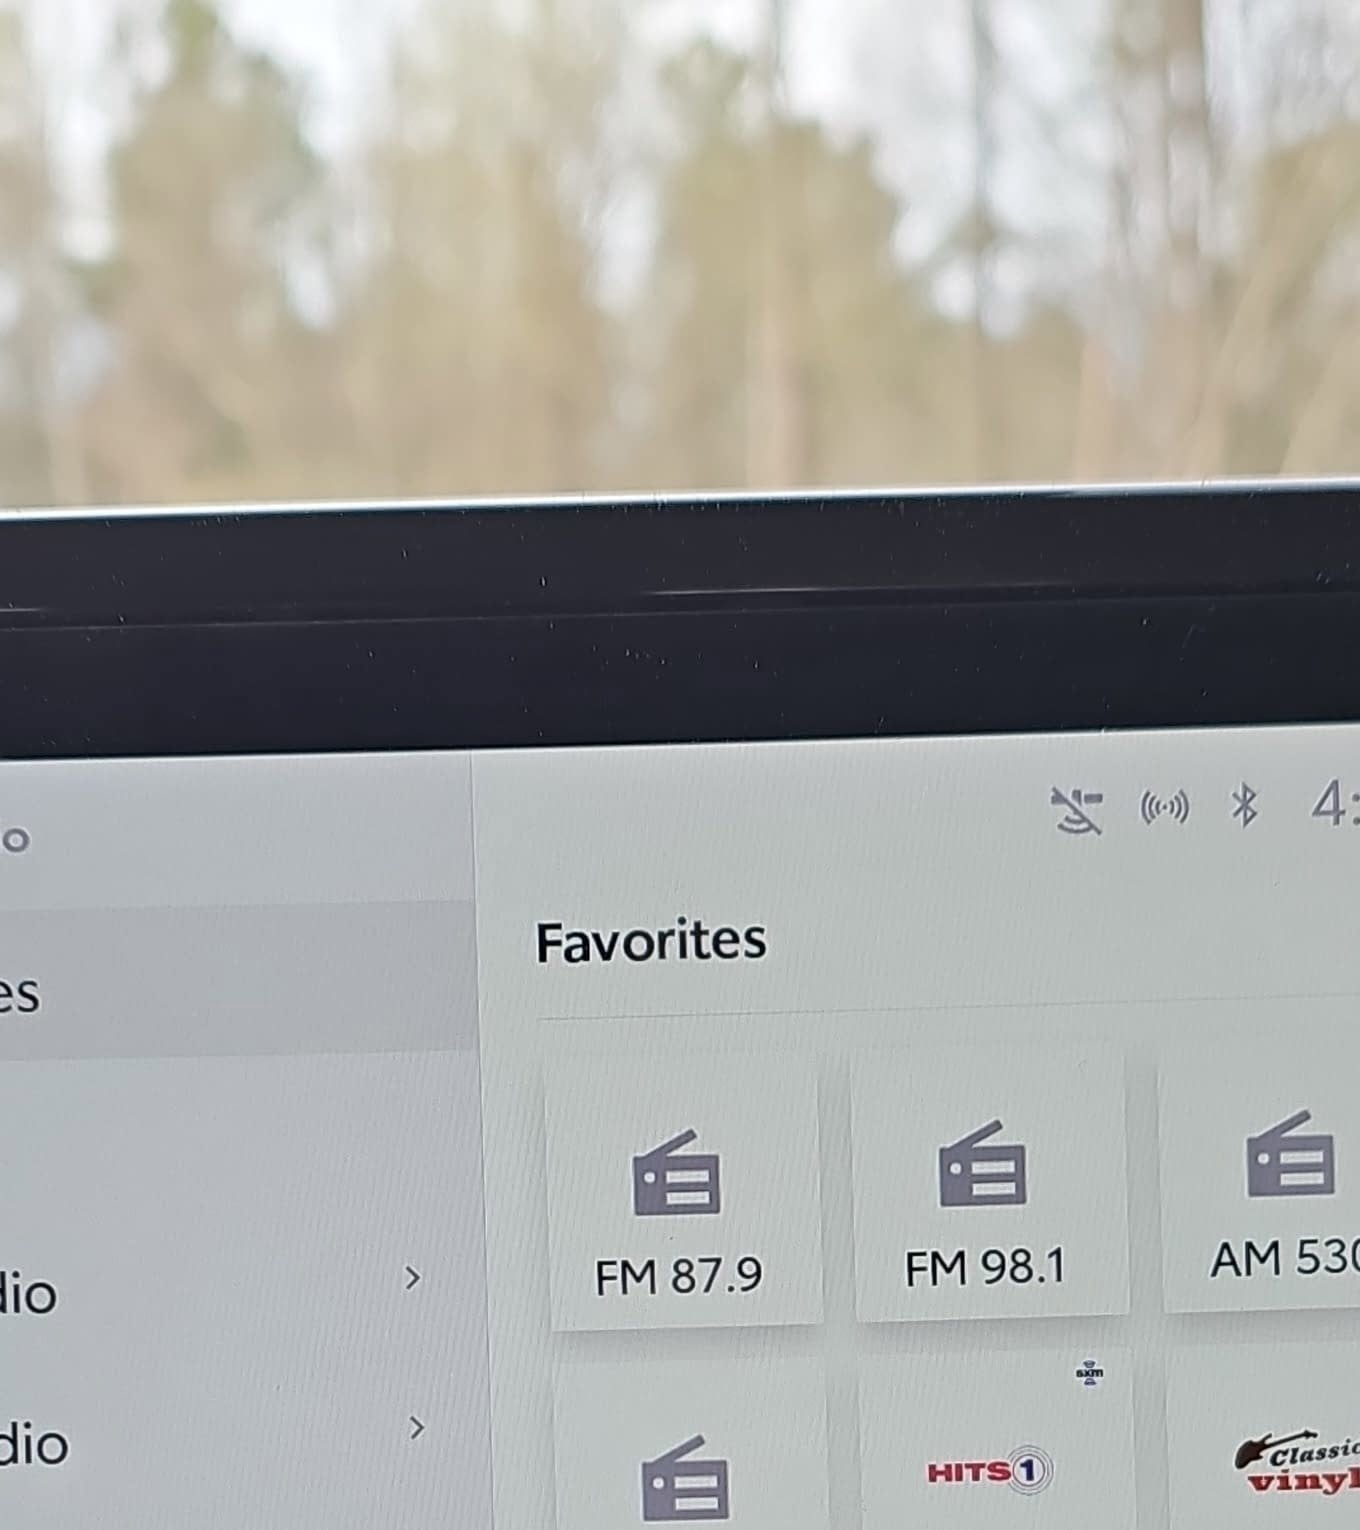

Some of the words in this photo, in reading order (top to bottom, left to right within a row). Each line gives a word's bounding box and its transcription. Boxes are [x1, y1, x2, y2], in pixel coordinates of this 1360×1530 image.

[536, 915, 768, 965] Favorites
[596, 1258, 657, 1297] FM
[670, 1255, 763, 1295] 87.9
[905, 1249, 967, 1288] FM
[980, 1245, 1063, 1286] 98.1
[1209, 1239, 1282, 1279] AM
